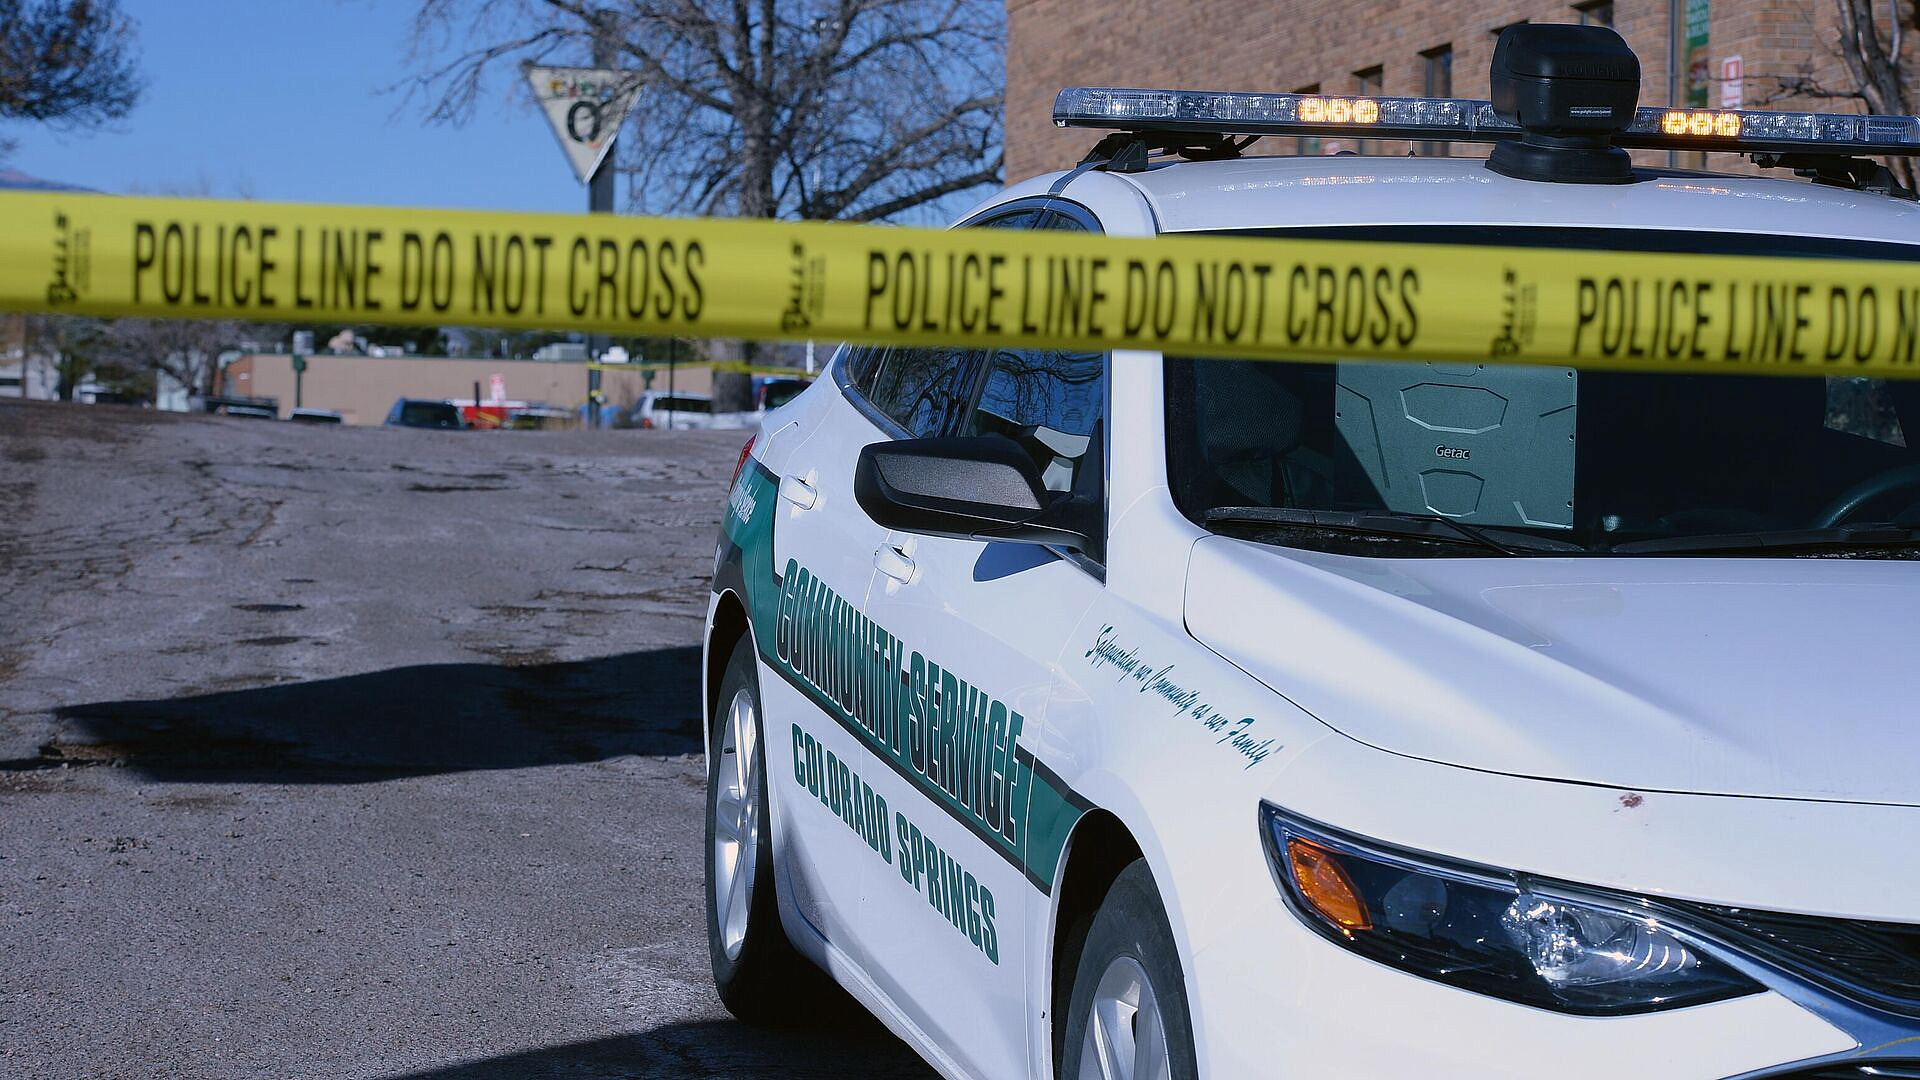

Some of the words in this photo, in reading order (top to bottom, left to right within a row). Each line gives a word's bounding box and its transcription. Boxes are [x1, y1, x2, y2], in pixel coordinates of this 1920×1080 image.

[133, 221, 278, 307] POLICE
[294, 229, 384, 311] LINE
[400, 231, 455, 314] DO
[469, 234, 554, 318] NOT
[567, 236, 706, 323] CROSS
[864, 250, 1006, 334] POLICE
[1020, 256, 1109, 339] LINE
[1124, 259, 1177, 339] DO
[1195, 262, 1273, 342] NOT
[1286, 265, 1420, 350] CROSS
[1573, 276, 1712, 357] POLICE
[1725, 283, 1813, 362] LINE
[1825, 285, 1880, 364] DO
[1435, 444, 1471, 460] Getac
[776, 558, 905, 757] COMMUNITY
[906, 650, 1025, 846] SERVICE
[1133, 664, 1153, 682] our
[1140, 664, 1201, 718] Community
[1191, 703, 1213, 720] as
[1203, 713, 1229, 733] our
[791, 721, 893, 866] COLORADO
[895, 810, 1000, 967] SPRINGS
